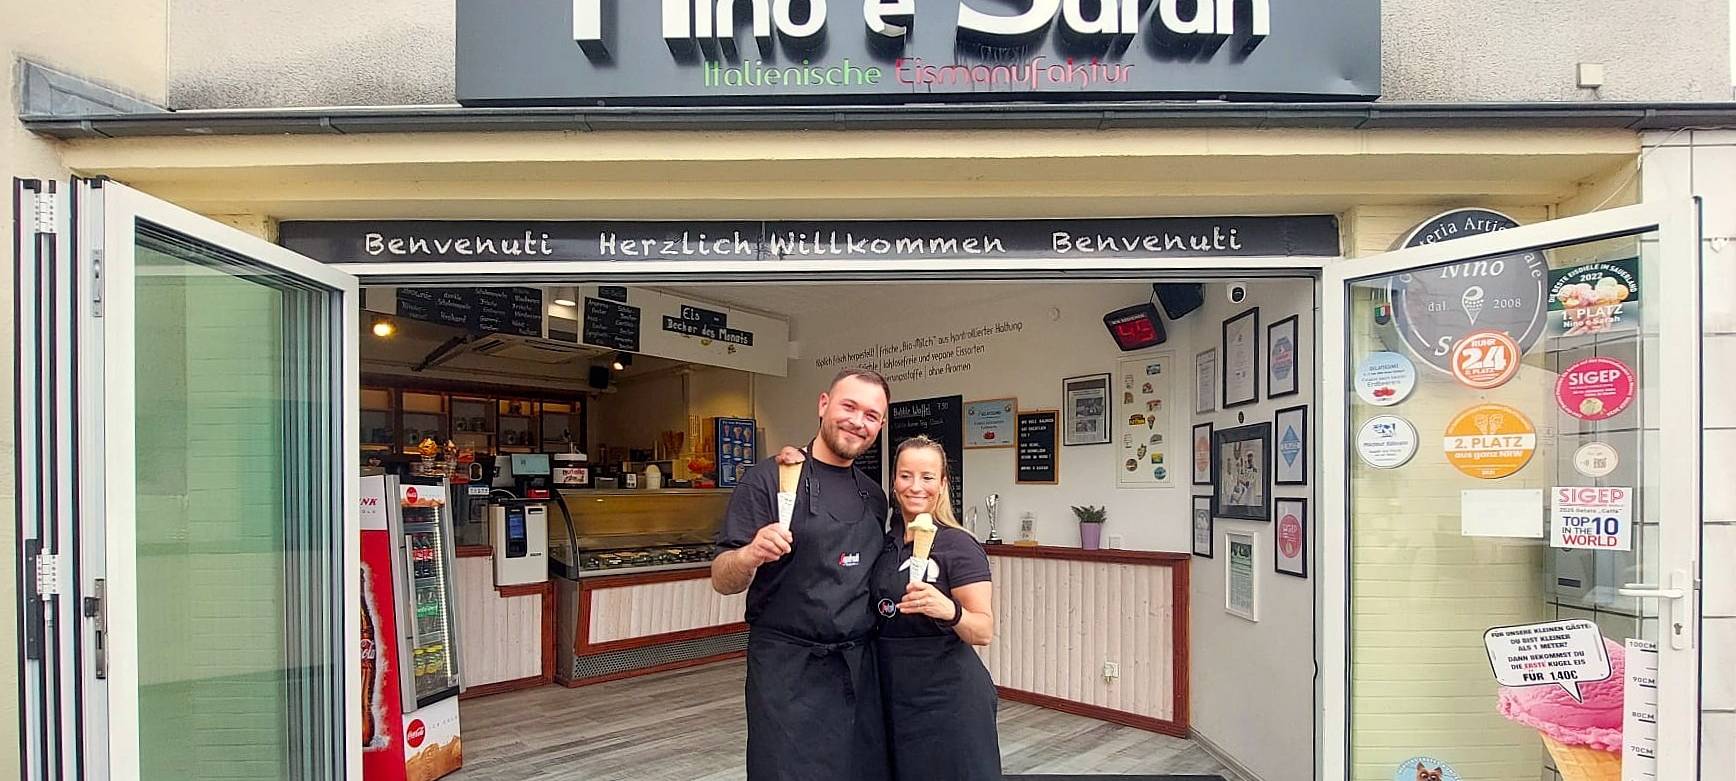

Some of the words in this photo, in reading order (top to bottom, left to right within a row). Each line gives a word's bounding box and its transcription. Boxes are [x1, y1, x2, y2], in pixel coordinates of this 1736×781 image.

[704, 58, 882, 87] Italienische
[895, 56, 1135, 90] Eismanufaktur
[365, 231, 552, 256] Benvenuti
[599, 231, 752, 257] Herzlich
[770, 231, 1006, 256] Willkommen
[1052, 227, 1241, 254] Benvenuti
[1551, 275, 1570, 293] BESTE
[1568, 263, 1600, 278] EISDIELE
[1608, 264, 1638, 293] SAUERLAND
[1580, 271, 1603, 282] 2022
[1428, 300, 1447, 312] dal
[1493, 298, 1522, 309] 2008
[682, 307, 700, 321] Eis
[1562, 311, 1573, 321] 1.
[1577, 304, 1623, 318] PLATZ
[1563, 319, 1584, 328] Nino
[1592, 316, 1621, 325] Sarah
[666, 318, 698, 334] Becher
[701, 324, 716, 338] des
[718, 328, 749, 345] Monats
[879, 343, 899, 357] frische
[938, 336, 949, 345] aus
[995, 320, 1023, 336] Haltung
[918, 351, 930, 363] und
[931, 349, 954, 363] vegane
[955, 343, 985, 357] Eissorten
[1462, 345, 1506, 370] 24
[928, 364, 944, 377] ohne
[945, 361, 971, 376] Aromen
[1568, 369, 1621, 386] SIGEP
[1454, 438, 1468, 449] 2.
[1471, 436, 1523, 449] PLATZ
[1558, 488, 1624, 503] SIGEP
[1561, 526, 1572, 534] IN
[1573, 527, 1592, 535] THE
[1562, 516, 1590, 527] TOP
[1591, 516, 1619, 536] 10
[1562, 534, 1618, 547] WORLD
[1505, 629, 1532, 637] UNSERE
[1534, 626, 1564, 634] KLEINEN
[1540, 634, 1571, 642] KLEINER
[1629, 640, 1657, 649] 100CM
[1507, 655, 1528, 663] DANN
[1530, 651, 1572, 661] BEKOMMST
[1524, 661, 1546, 669] ERSTE
[1547, 660, 1572, 668] KUGEL
[1522, 669, 1545, 682] FÜR
[1632, 676, 1656, 685] 90CM
[1631, 711, 1655, 720] 80CM
[1630, 745, 1654, 755] 70CM
